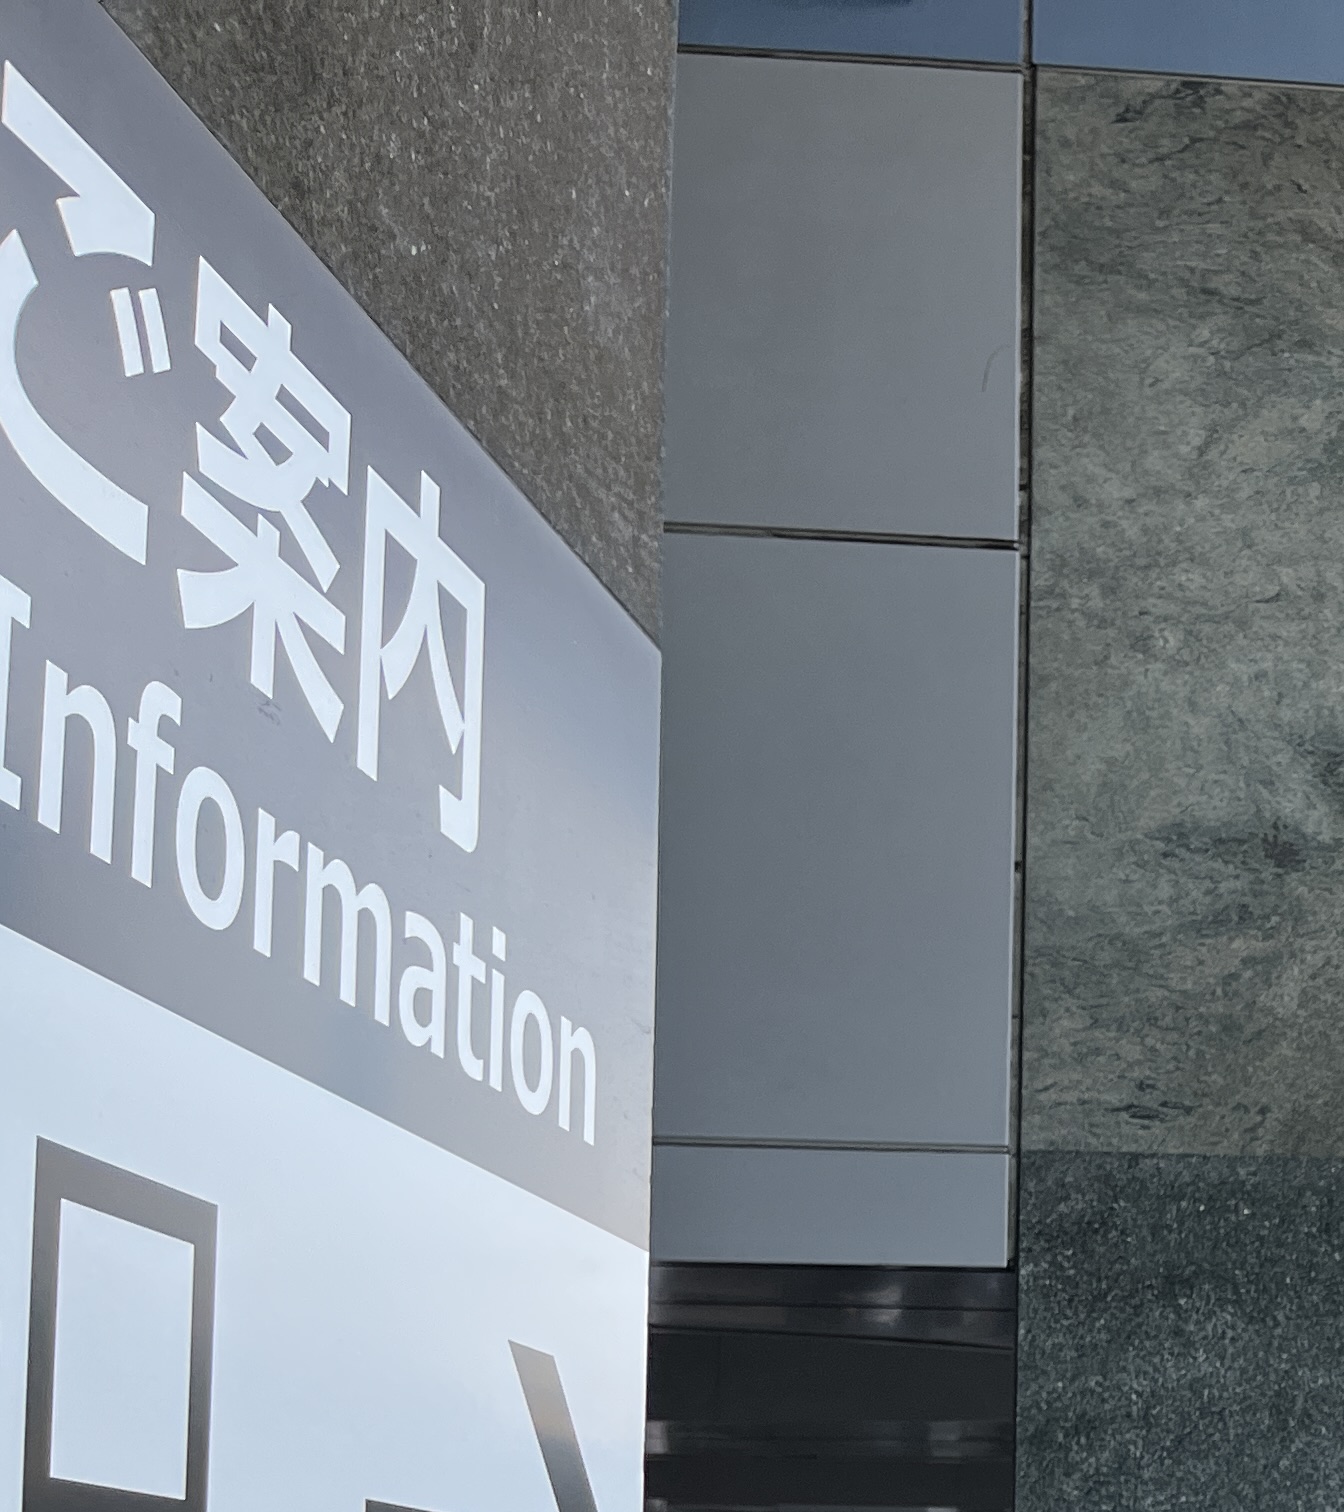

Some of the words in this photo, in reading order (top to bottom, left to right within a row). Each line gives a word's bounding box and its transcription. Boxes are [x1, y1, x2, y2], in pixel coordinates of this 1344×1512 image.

[0, 60, 486, 853] ご案内
[0, 574, 597, 1146] Information
